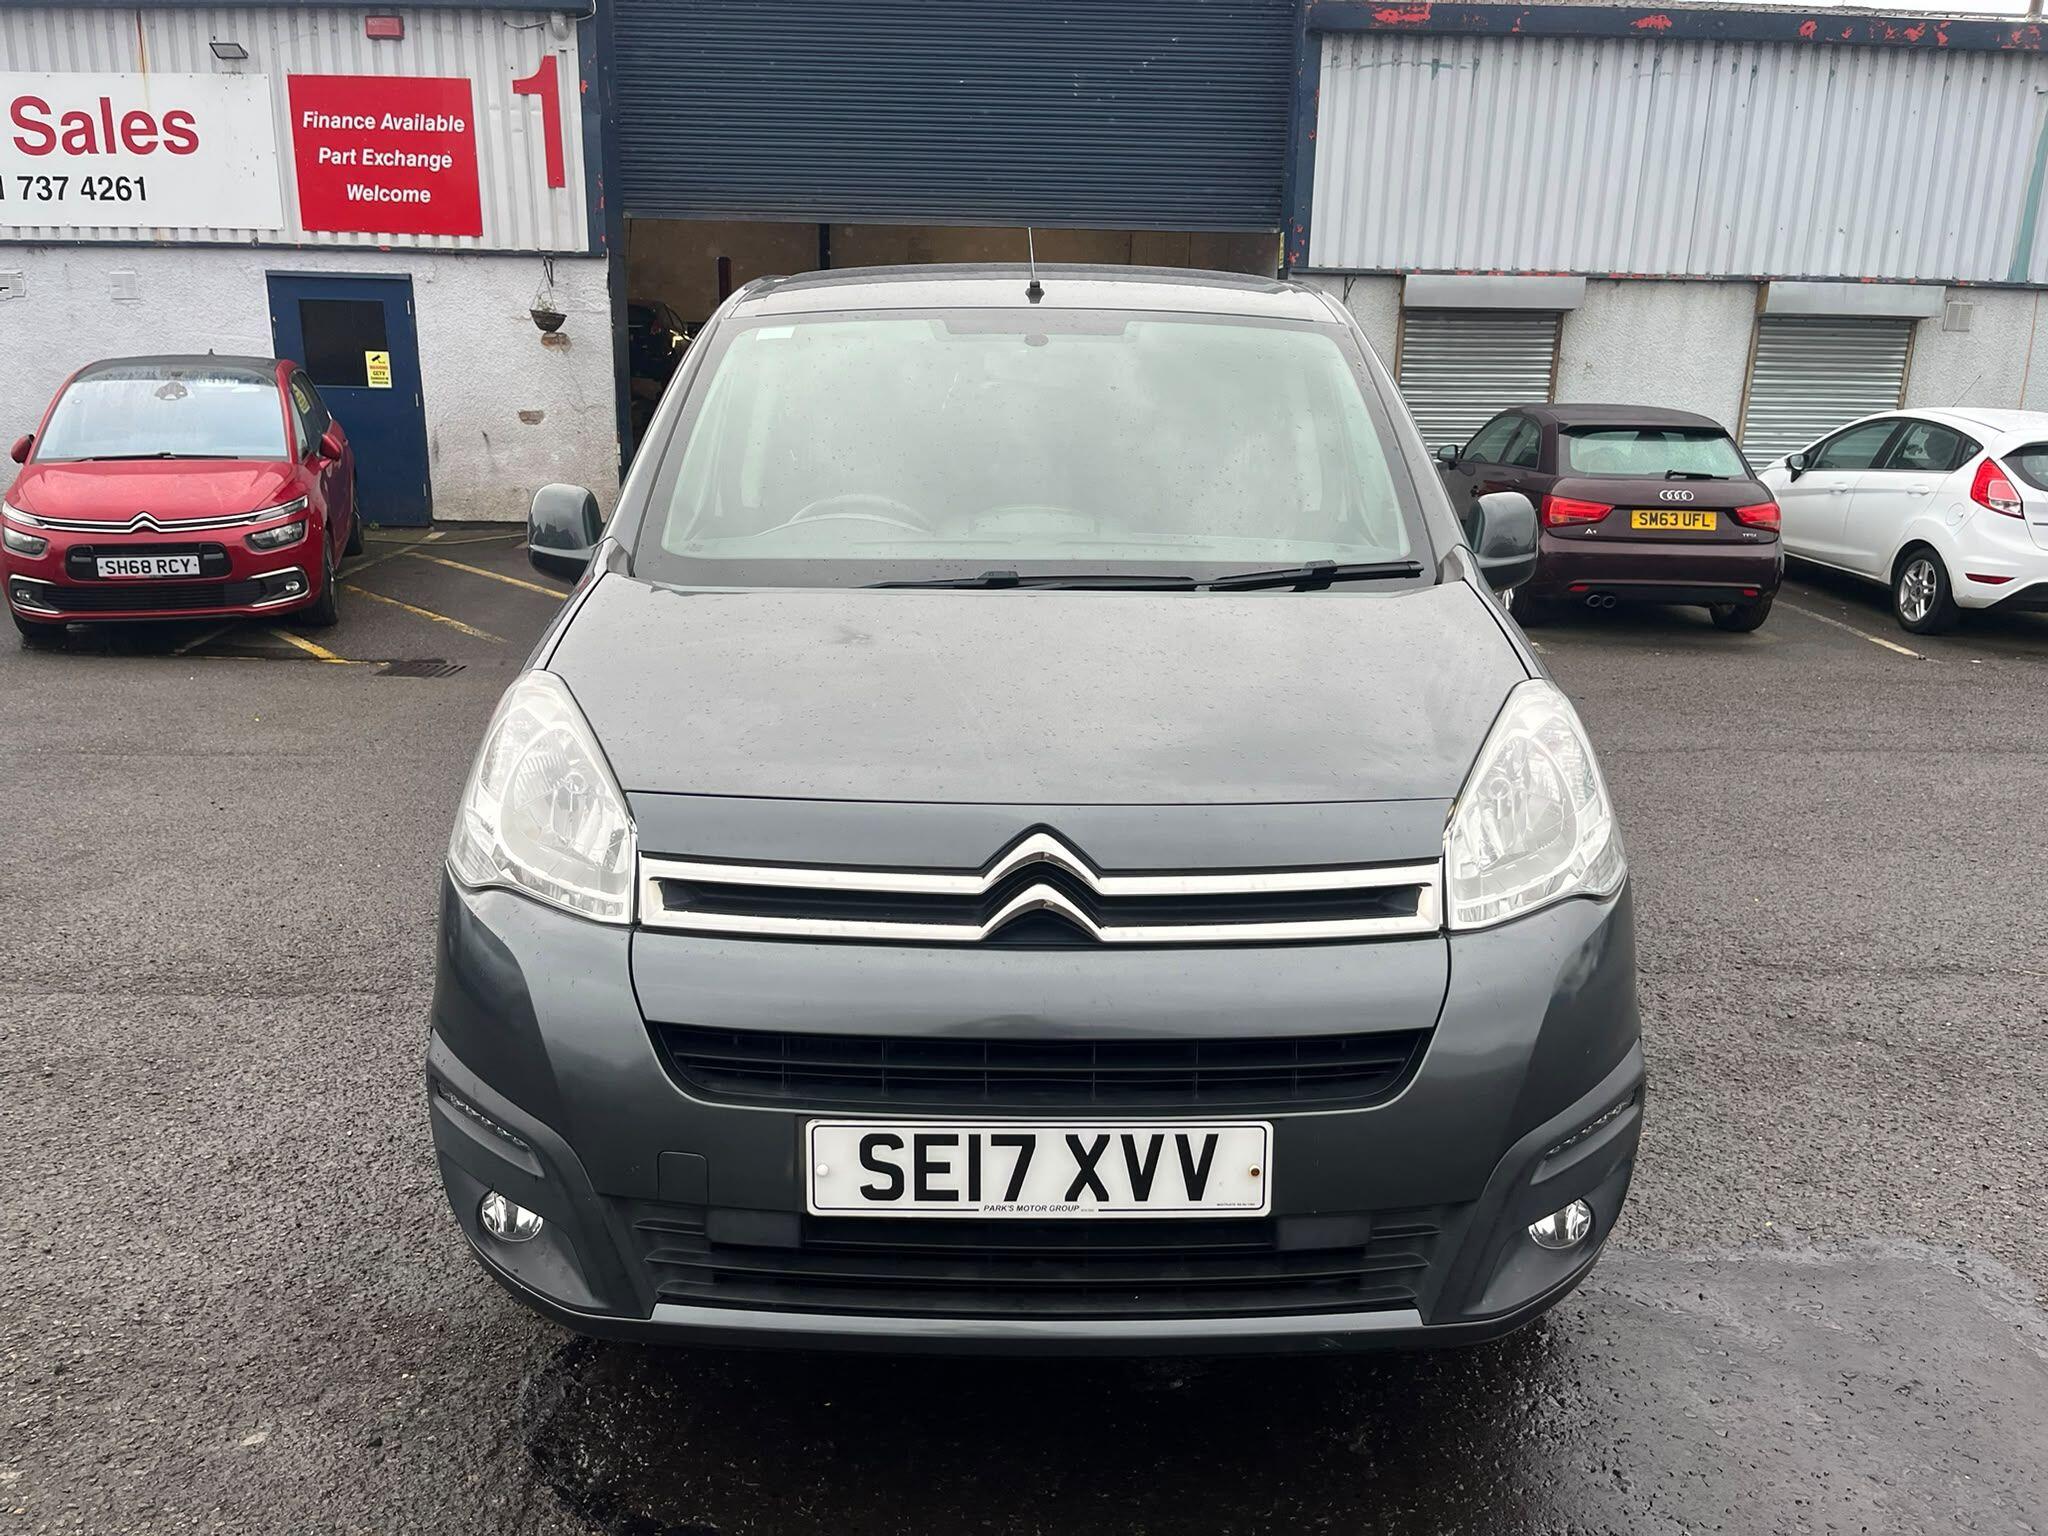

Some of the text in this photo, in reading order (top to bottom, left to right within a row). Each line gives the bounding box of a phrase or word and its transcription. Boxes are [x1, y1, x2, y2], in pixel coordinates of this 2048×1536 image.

[10, 95, 200, 156] Sales
[302, 111, 465, 132] Finance Available
[512, 55, 566, 189] 1
[318, 147, 453, 172] Part Exchange
[16, 175, 70, 201] 737
[80, 176, 147, 201] 4261
[346, 184, 432, 203] Welcome
[1639, 512, 1711, 527] SM63 UFL
[105, 558, 190, 575] SH68 RCY
[859, 1133, 1220, 1202] SE17 XVV
[983, 1204, 1015, 1212] PARK'S
[1016, 1204, 1048, 1212] MOTOR
[1049, 1204, 1080, 1212] GROUP
